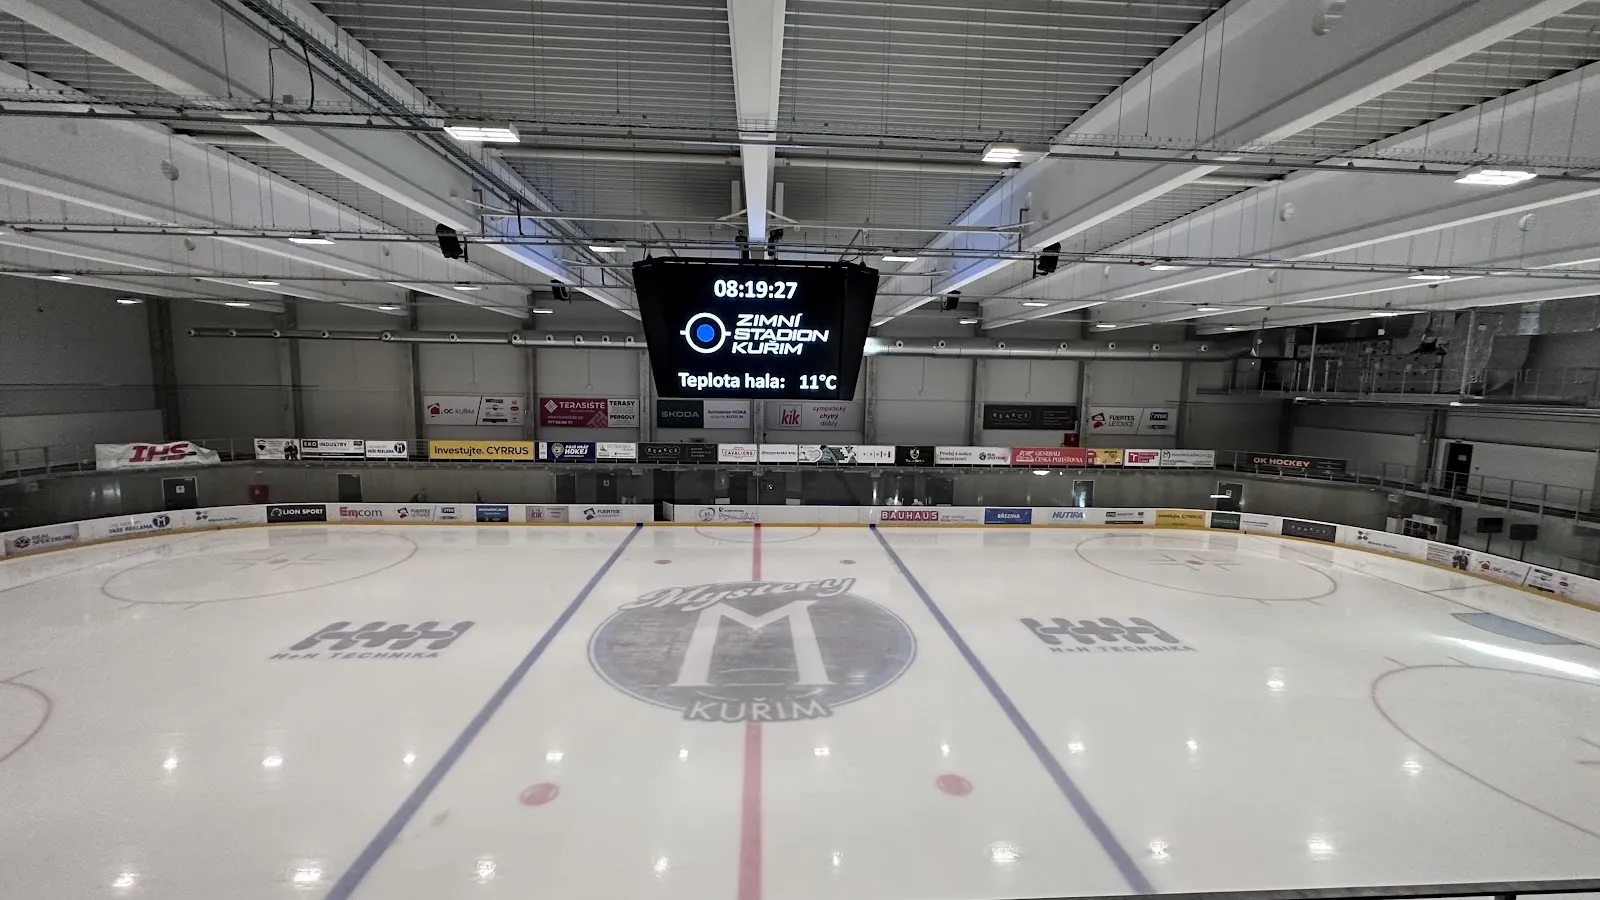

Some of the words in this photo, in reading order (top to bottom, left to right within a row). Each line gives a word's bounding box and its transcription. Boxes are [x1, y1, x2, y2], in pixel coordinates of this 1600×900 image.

[714, 279, 798, 299] 08:19:27
[736, 313, 803, 327] ZIMNÍ
[733, 328, 830, 342] STADION
[731, 340, 803, 355] KUŘIM
[677, 372, 740, 390] Teplota
[744, 372, 785, 389] hala:
[799, 374, 837, 390] 11°C
[781, 409, 800, 424] kik
[129, 443, 189, 462] IHS
[434, 446, 484, 456] Investujte.
[486, 446, 529, 455] CYRRUS
[1269, 458, 1311, 468] HOCKEY
[881, 511, 938, 520] BAUHAUS
[619, 578, 856, 611] Mystery
[688, 697, 827, 721] KUŘIM
